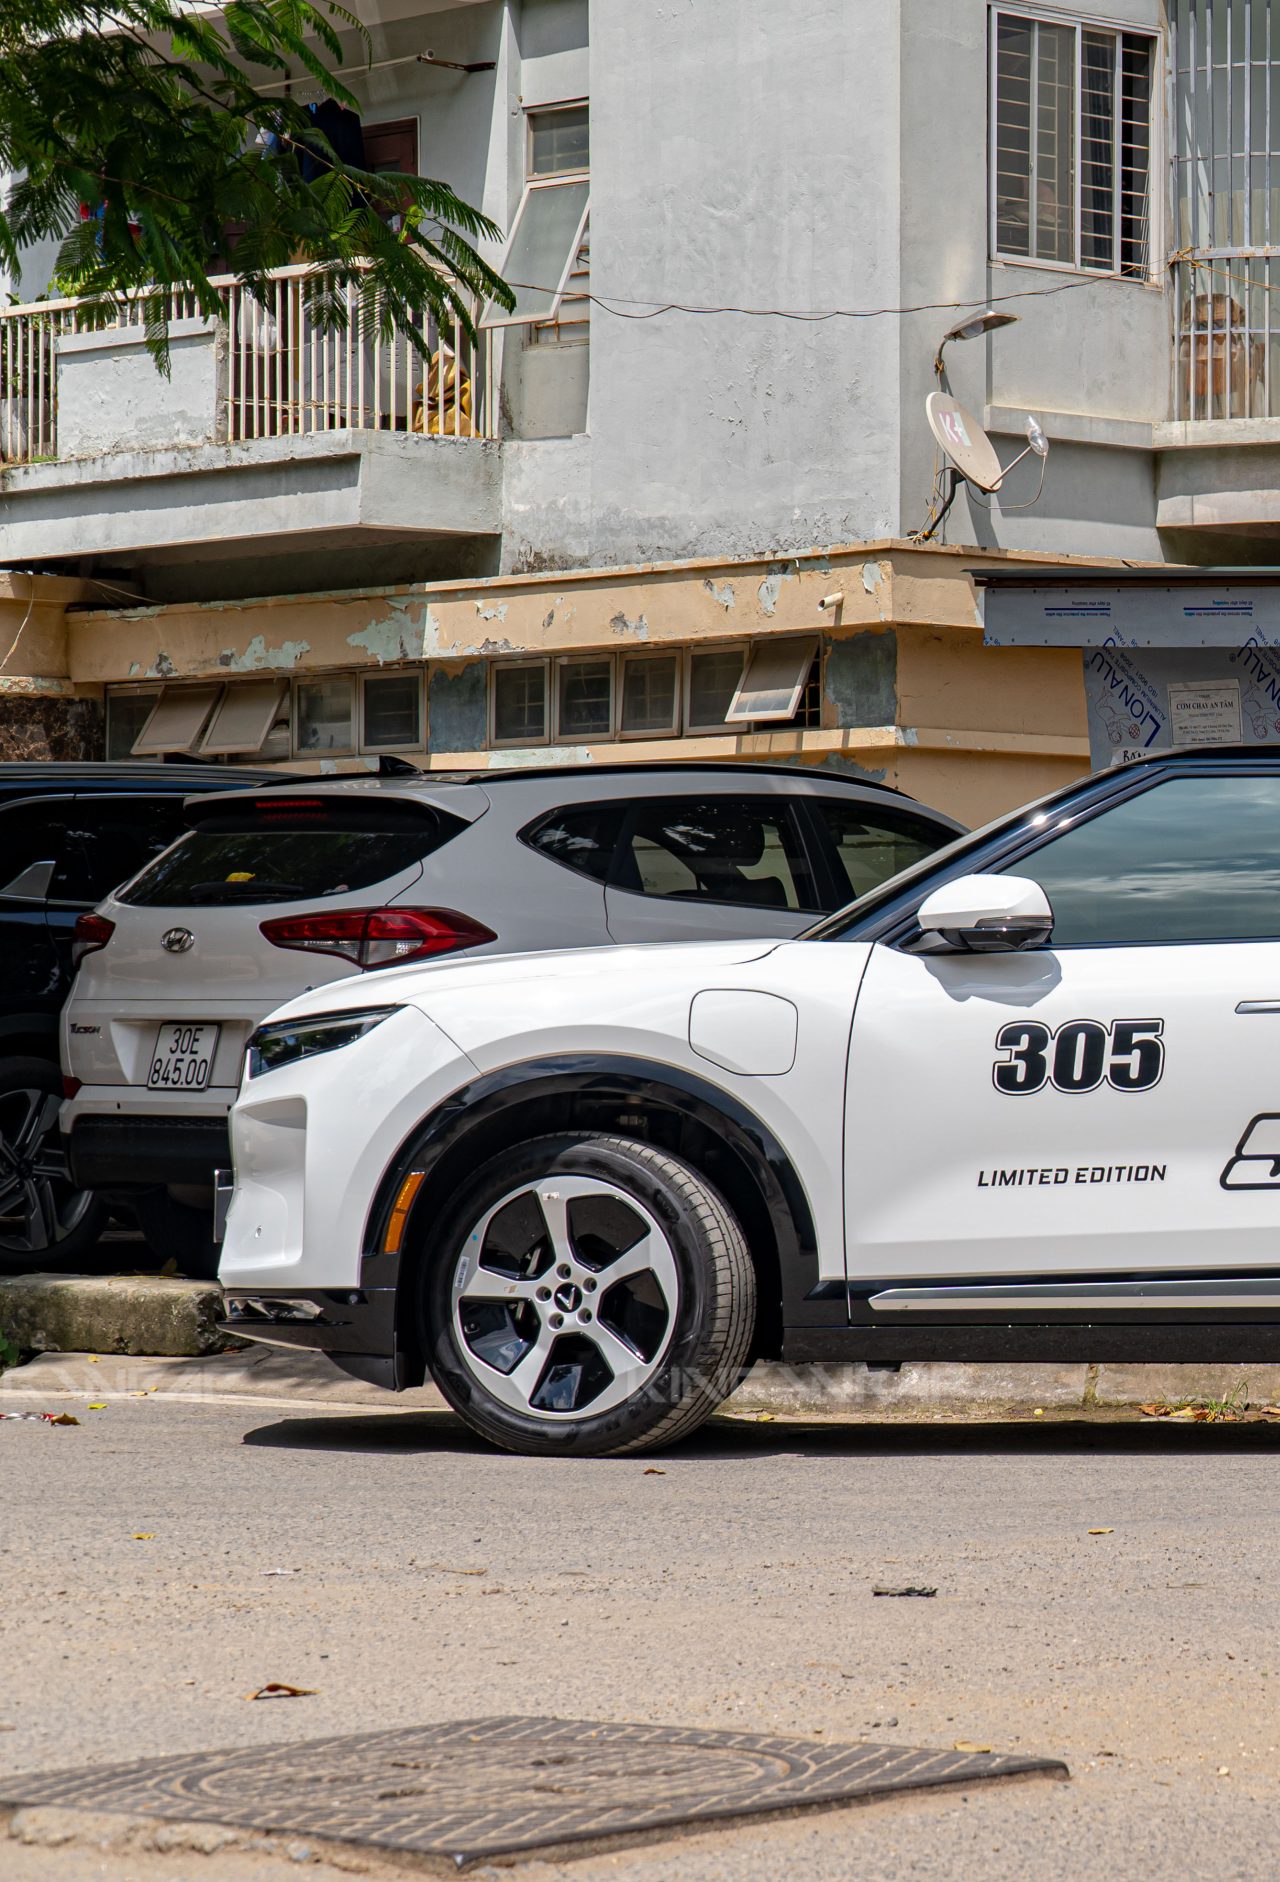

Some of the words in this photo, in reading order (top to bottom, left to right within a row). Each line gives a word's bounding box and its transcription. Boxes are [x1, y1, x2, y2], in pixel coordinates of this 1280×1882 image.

[170, 1028, 204, 1055] 30E
[991, 1017, 1166, 1096] 305
[150, 1058, 208, 1086] 845.00
[977, 1168, 1069, 1188] LIMITED
[1074, 1164, 1167, 1184] EDITION
